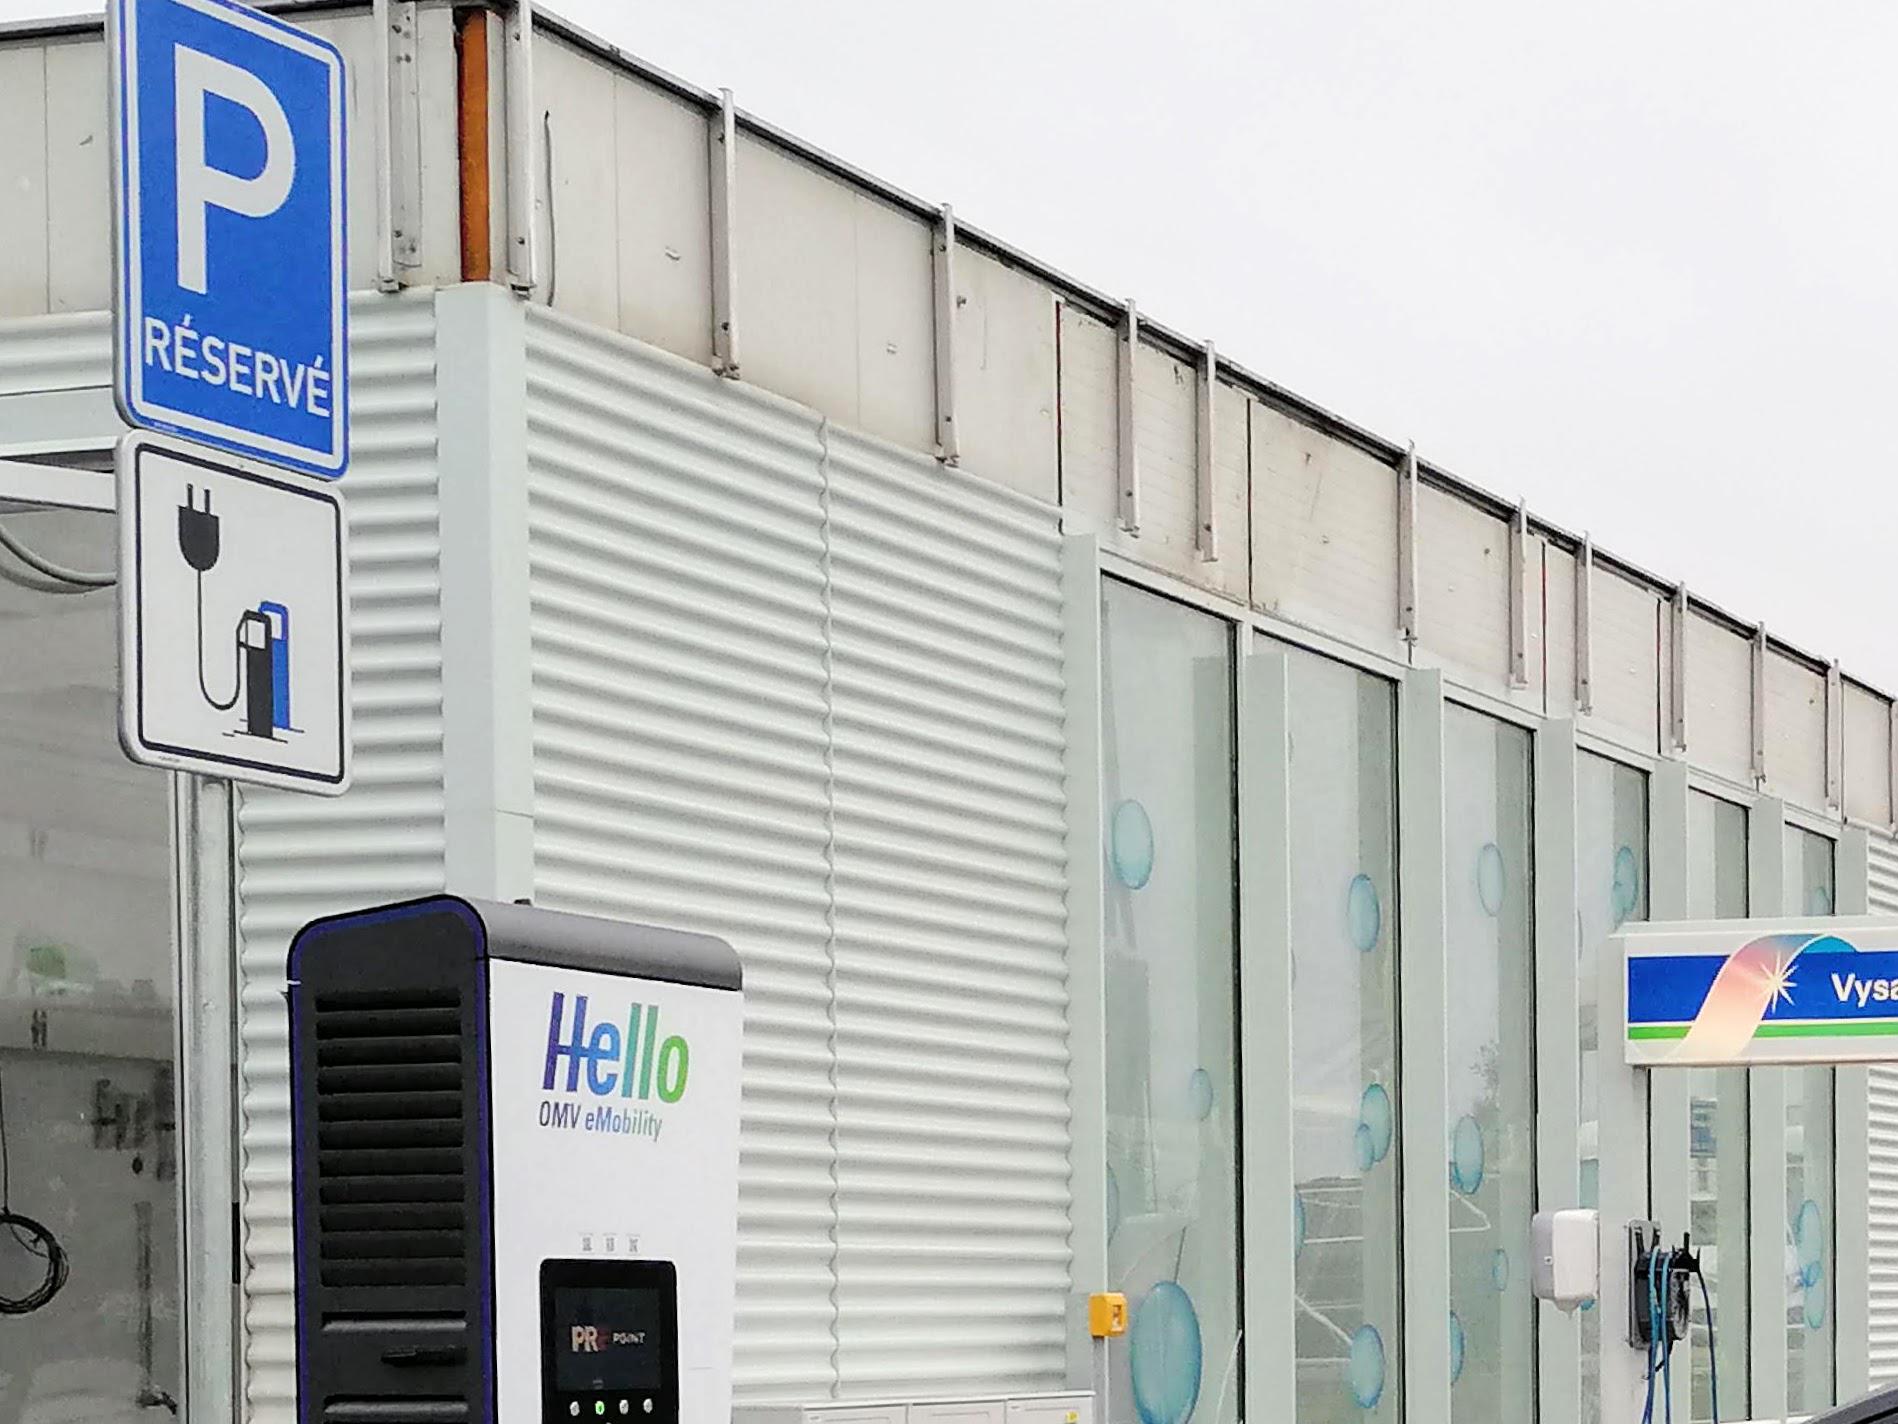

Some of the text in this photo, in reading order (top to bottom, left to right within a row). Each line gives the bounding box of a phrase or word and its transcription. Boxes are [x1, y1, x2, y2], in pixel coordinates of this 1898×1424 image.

[175, 43, 296, 295] P
[145, 314, 330, 417] RÉSERVÉ
[542, 992, 689, 1104] Hello
[539, 1101, 663, 1142] OMV eMobility
